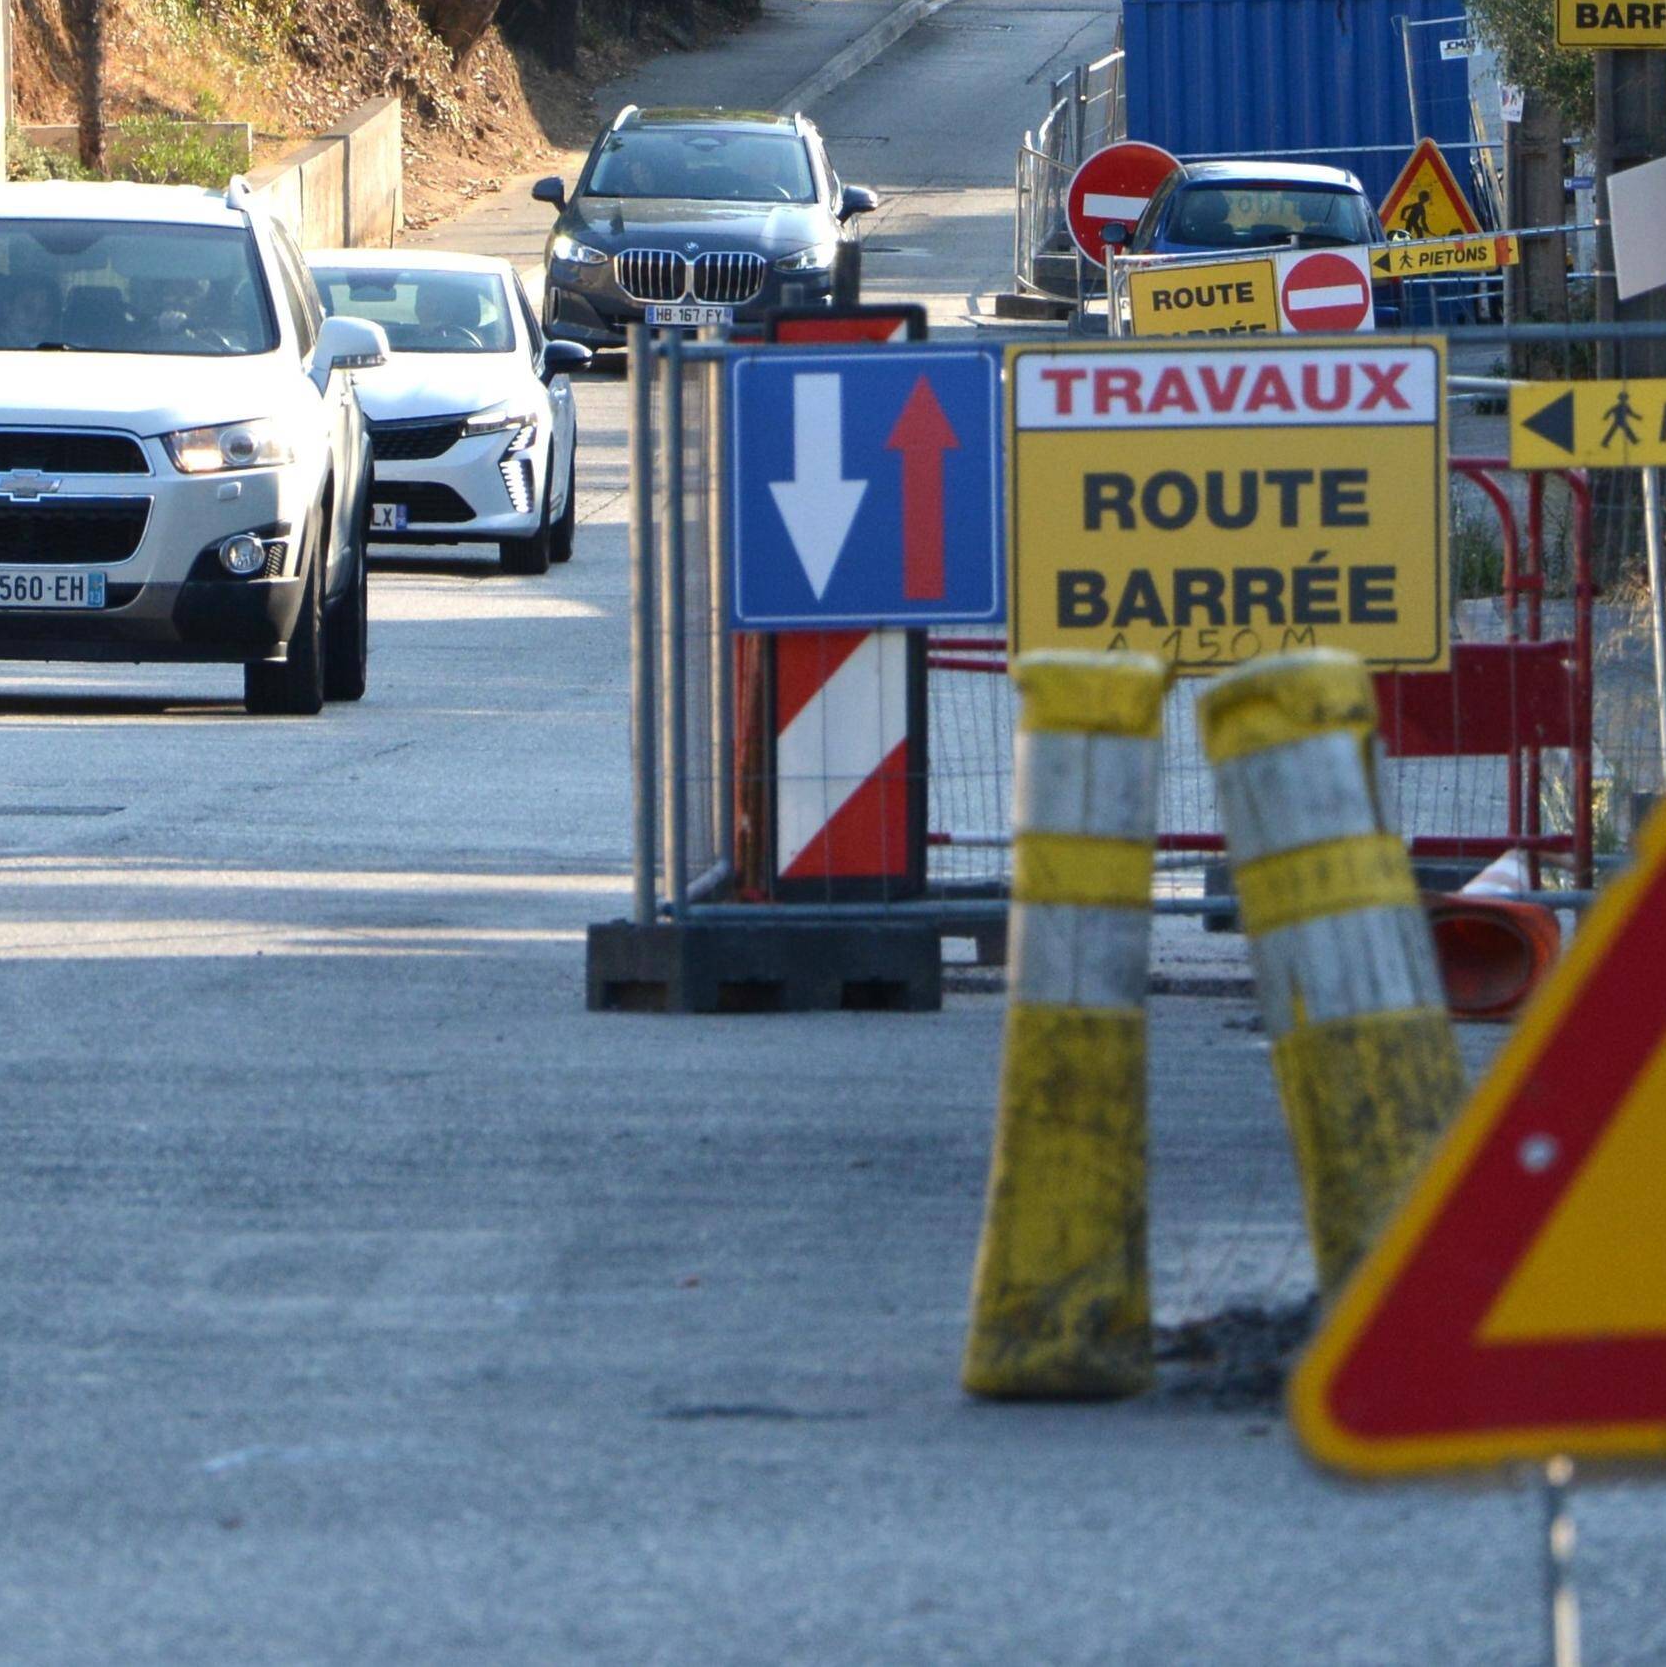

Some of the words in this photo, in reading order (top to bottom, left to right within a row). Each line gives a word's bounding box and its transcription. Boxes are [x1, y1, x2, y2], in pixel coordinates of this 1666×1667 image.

[1419, 245, 1488, 267] PIETONS
[1151, 281, 1255, 312] ROUTE
[1040, 361, 1414, 416] TRAVAUX
[1082, 468, 1370, 532] ROUTE
[1056, 549, 1398, 629] BARRÉE
[1161, 626, 1262, 663] 150
